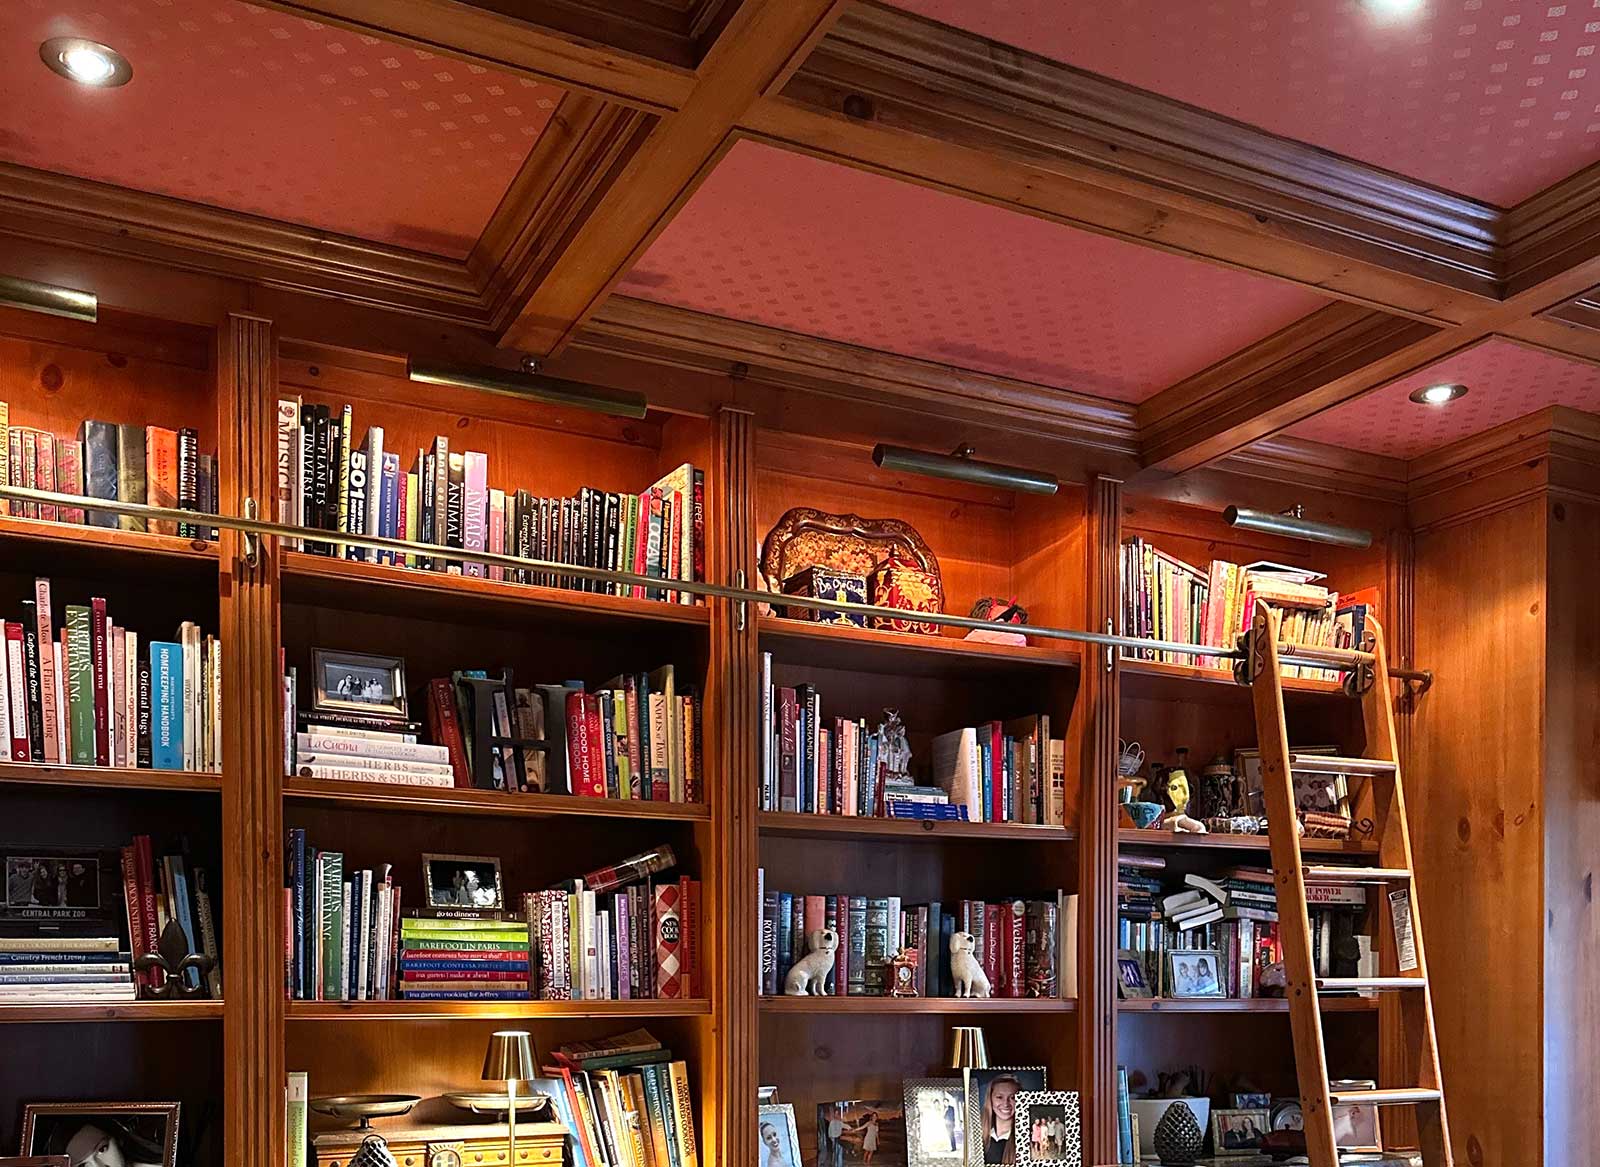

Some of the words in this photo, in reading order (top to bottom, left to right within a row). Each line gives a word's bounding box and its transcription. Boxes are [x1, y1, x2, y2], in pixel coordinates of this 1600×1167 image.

[181, 436, 196, 462] DAN
[279, 421, 289, 484] MUSIC
[438, 441, 446, 480] planet
[304, 433, 313, 498] UNIVERSE
[316, 447, 326, 505] PLANETS
[350, 451, 366, 498] 501
[181, 461, 196, 501] BROWN
[437, 487, 446, 519] earth
[447, 482, 460, 540] ANIMAL
[694, 502, 703, 523] reef
[466, 488, 481, 548] ANIMALS
[648, 522, 660, 565] OCEAN
[673, 538, 679, 548] OF
[38, 583, 49, 622] Charlotte
[27, 632, 36, 658] Carpets
[41, 623, 50, 645] Moss
[78, 611, 91, 672] MARTHA'S
[43, 657, 52, 665] A
[66, 610, 81, 703] ENTERTAINING
[29, 667, 37, 678] the
[44, 668, 54, 690] Flair
[160, 648, 169, 704] HOMEKEEPING
[30, 680, 38, 702] Orient
[45, 692, 56, 706] for
[139, 671, 149, 709] Oriental
[45, 709, 57, 738] Living
[128, 697, 136, 732] organized
[139, 711, 149, 735] Rugs
[604, 718, 612, 732] great
[628, 696, 636, 726] BAKING
[655, 699, 664, 731] NAPLES
[781, 698, 794, 726] Leonardo
[161, 705, 169, 747] HANDBOOK
[579, 725, 588, 753] GOOD
[784, 727, 791, 736] da
[307, 739, 322, 749] La
[322, 740, 358, 752] Cucina
[571, 715, 580, 770] COOKBOOK
[657, 740, 665, 766] TABLE
[331, 770, 375, 781] HERBS
[378, 772, 389, 782] &
[390, 772, 434, 785] SPICES
[363, 760, 409, 771] HERBS
[582, 755, 590, 783] HOME
[322, 856, 331, 941] ENTERTAINING
[331, 857, 342, 912] MARTHA'S
[22, 909, 51, 918] CENTRAL
[53, 909, 71, 918] PARK
[72, 910, 86, 918] ZOO
[145, 894, 154, 912] food
[146, 912, 154, 921] of
[974, 903, 982, 916] DAN
[130, 905, 140, 948] INTERIORS
[148, 922, 158, 954] FRANCE
[661, 926, 679, 934] COOK
[974, 917, 983, 938] BROWN
[64, 954, 86, 962] Living
[620, 936, 628, 981] CUPCAKES
[762, 919, 772, 973] ROMANOVS
[772, 950, 777, 958] OF
[1013, 918, 1022, 978] Webster's
[648, 1069, 656, 1085] OLD
[650, 1086, 661, 1117] FISHING
[666, 1102, 674, 1134] Collectibles
[675, 1077, 685, 1119] ILLUSTRATED
[680, 1119, 690, 1157] COOKBOOK
